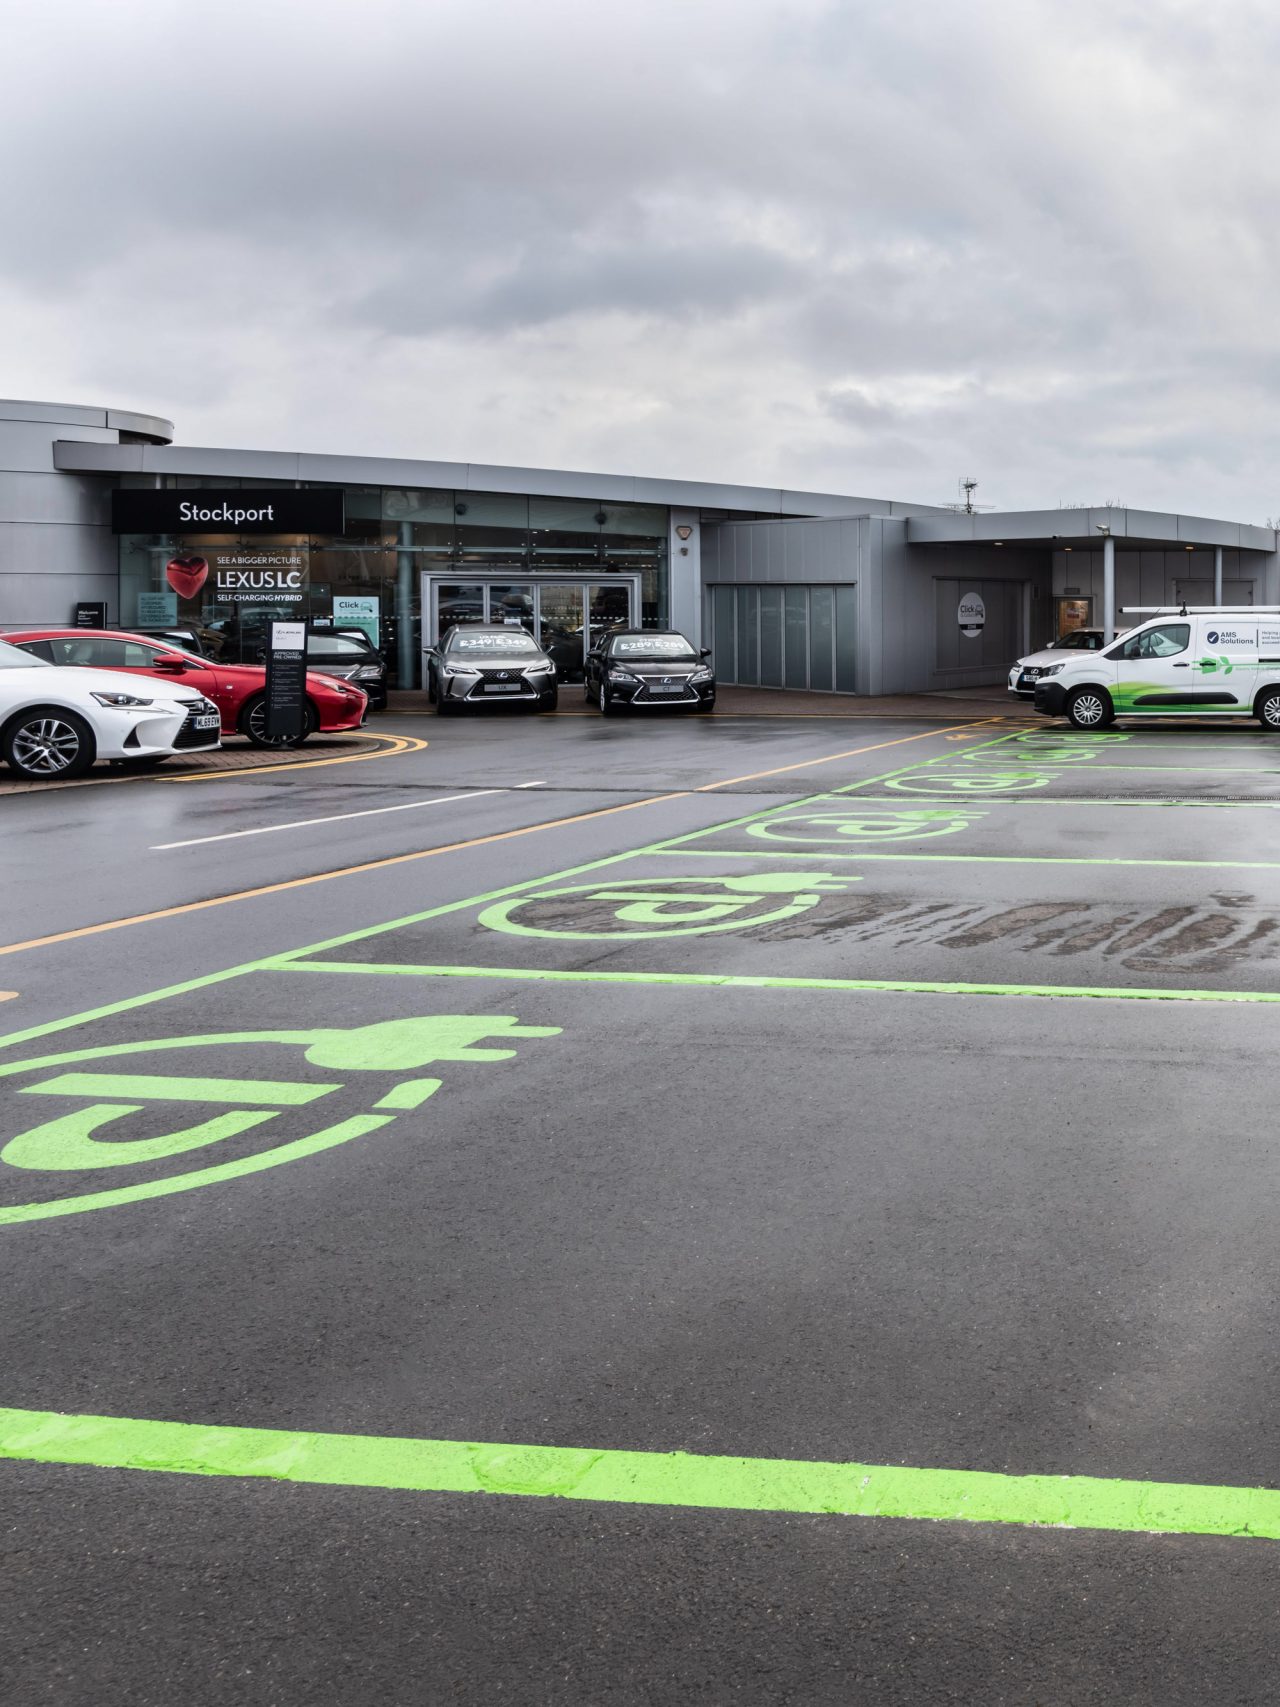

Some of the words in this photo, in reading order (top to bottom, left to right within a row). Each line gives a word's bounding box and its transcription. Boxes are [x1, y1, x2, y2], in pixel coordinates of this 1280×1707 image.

[179, 502, 274, 524] Stockport
[217, 556, 230, 564] SEE
[231, 556, 237, 564] A
[237, 556, 267, 564] BIGGER
[268, 556, 302, 564] PICTURE
[217, 571, 275, 588] LEXUS
[277, 571, 301, 588] LC
[217, 594, 276, 602] SELF-CHARGING
[274, 594, 303, 602] HYBRID
[339, 601, 359, 609] Click
